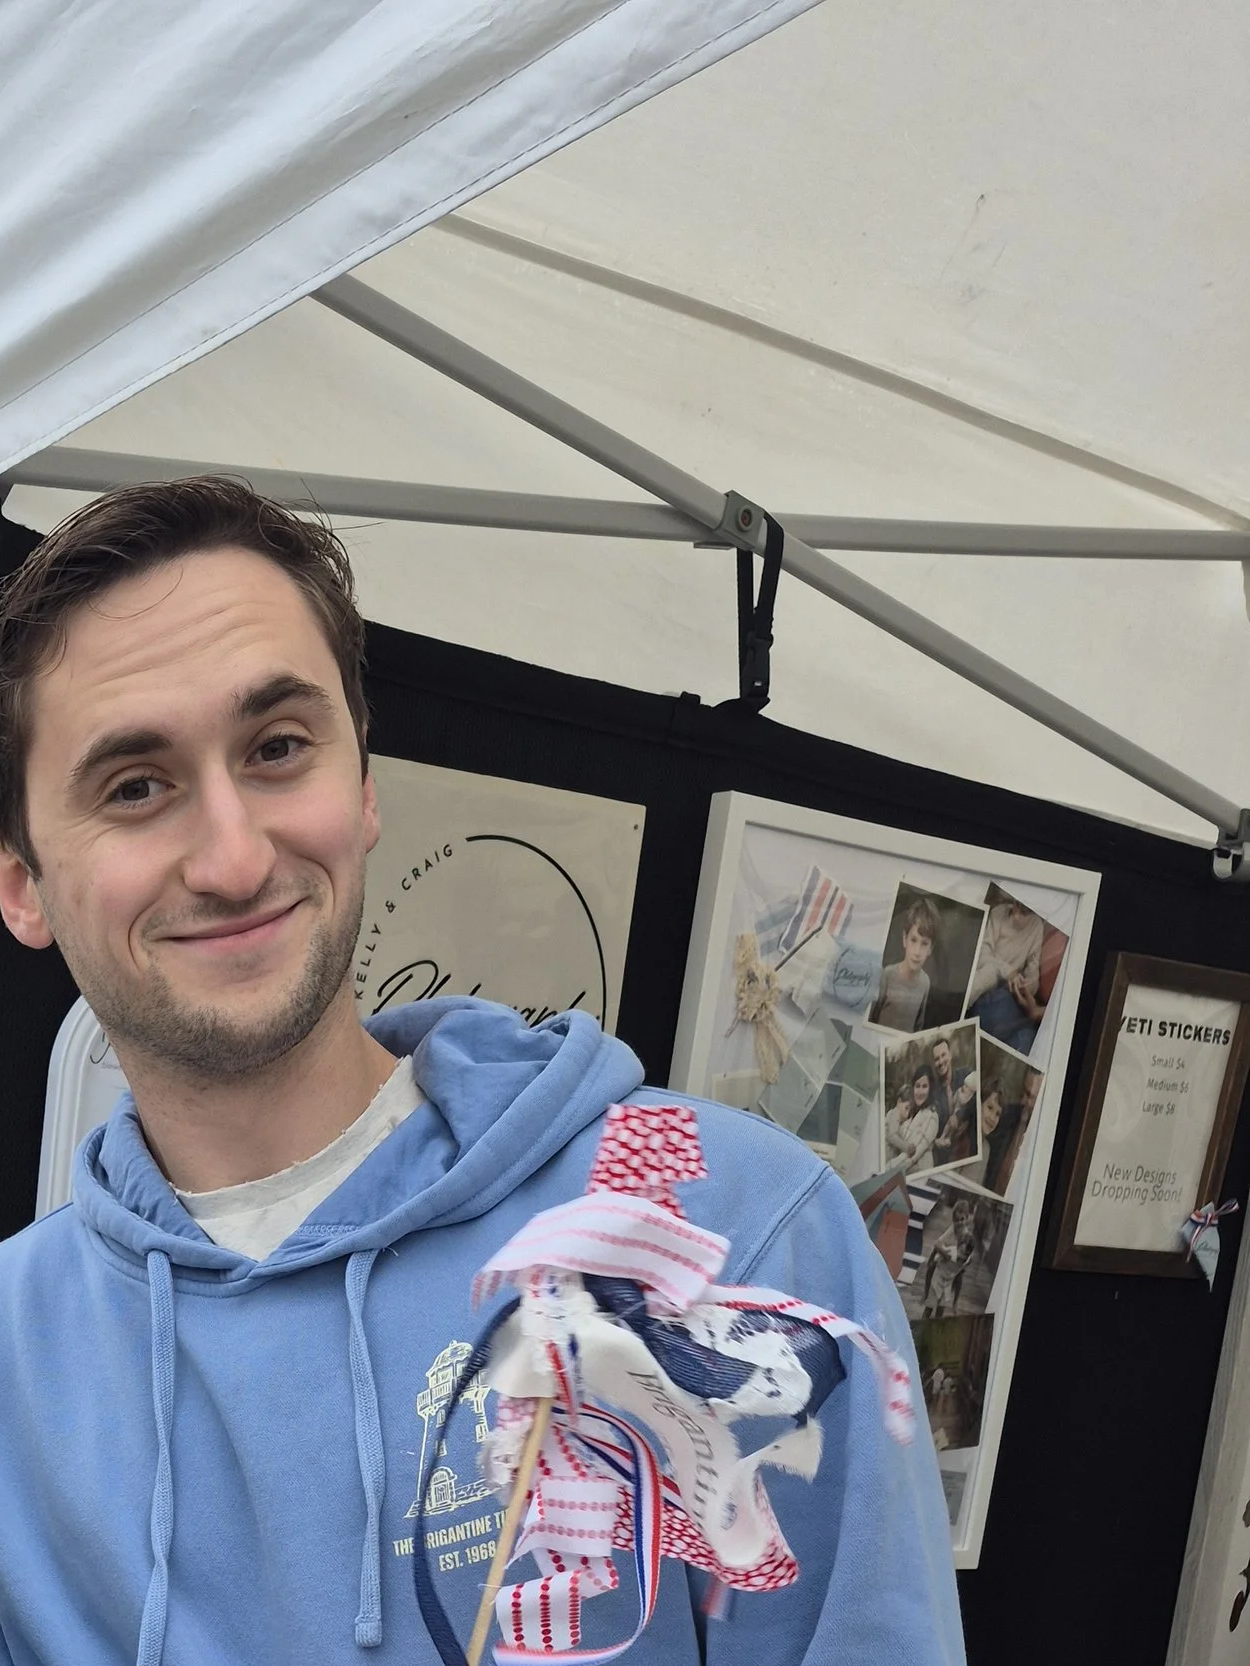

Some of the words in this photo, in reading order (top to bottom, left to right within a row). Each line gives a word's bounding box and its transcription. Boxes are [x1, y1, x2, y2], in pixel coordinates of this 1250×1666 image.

[354, 924, 382, 1000] KELLY
[385, 900, 396, 913] &
[402, 844, 453, 891] CRAIG
[1158, 1021, 1231, 1046] STICKERS
[1151, 1055, 1174, 1069] Small
[1146, 1078, 1178, 1092] Medium
[1142, 1101, 1164, 1116] Large
[1103, 1163, 1131, 1181] New
[1134, 1165, 1177, 1189] Designs
[1092, 1181, 1150, 1206] Dropping
[1150, 1184, 1182, 1204] Soon!
[425, 1515, 492, 1549] RIGANTINE
[438, 1551, 464, 1572] EST.
[465, 1540, 496, 1564] 1968
